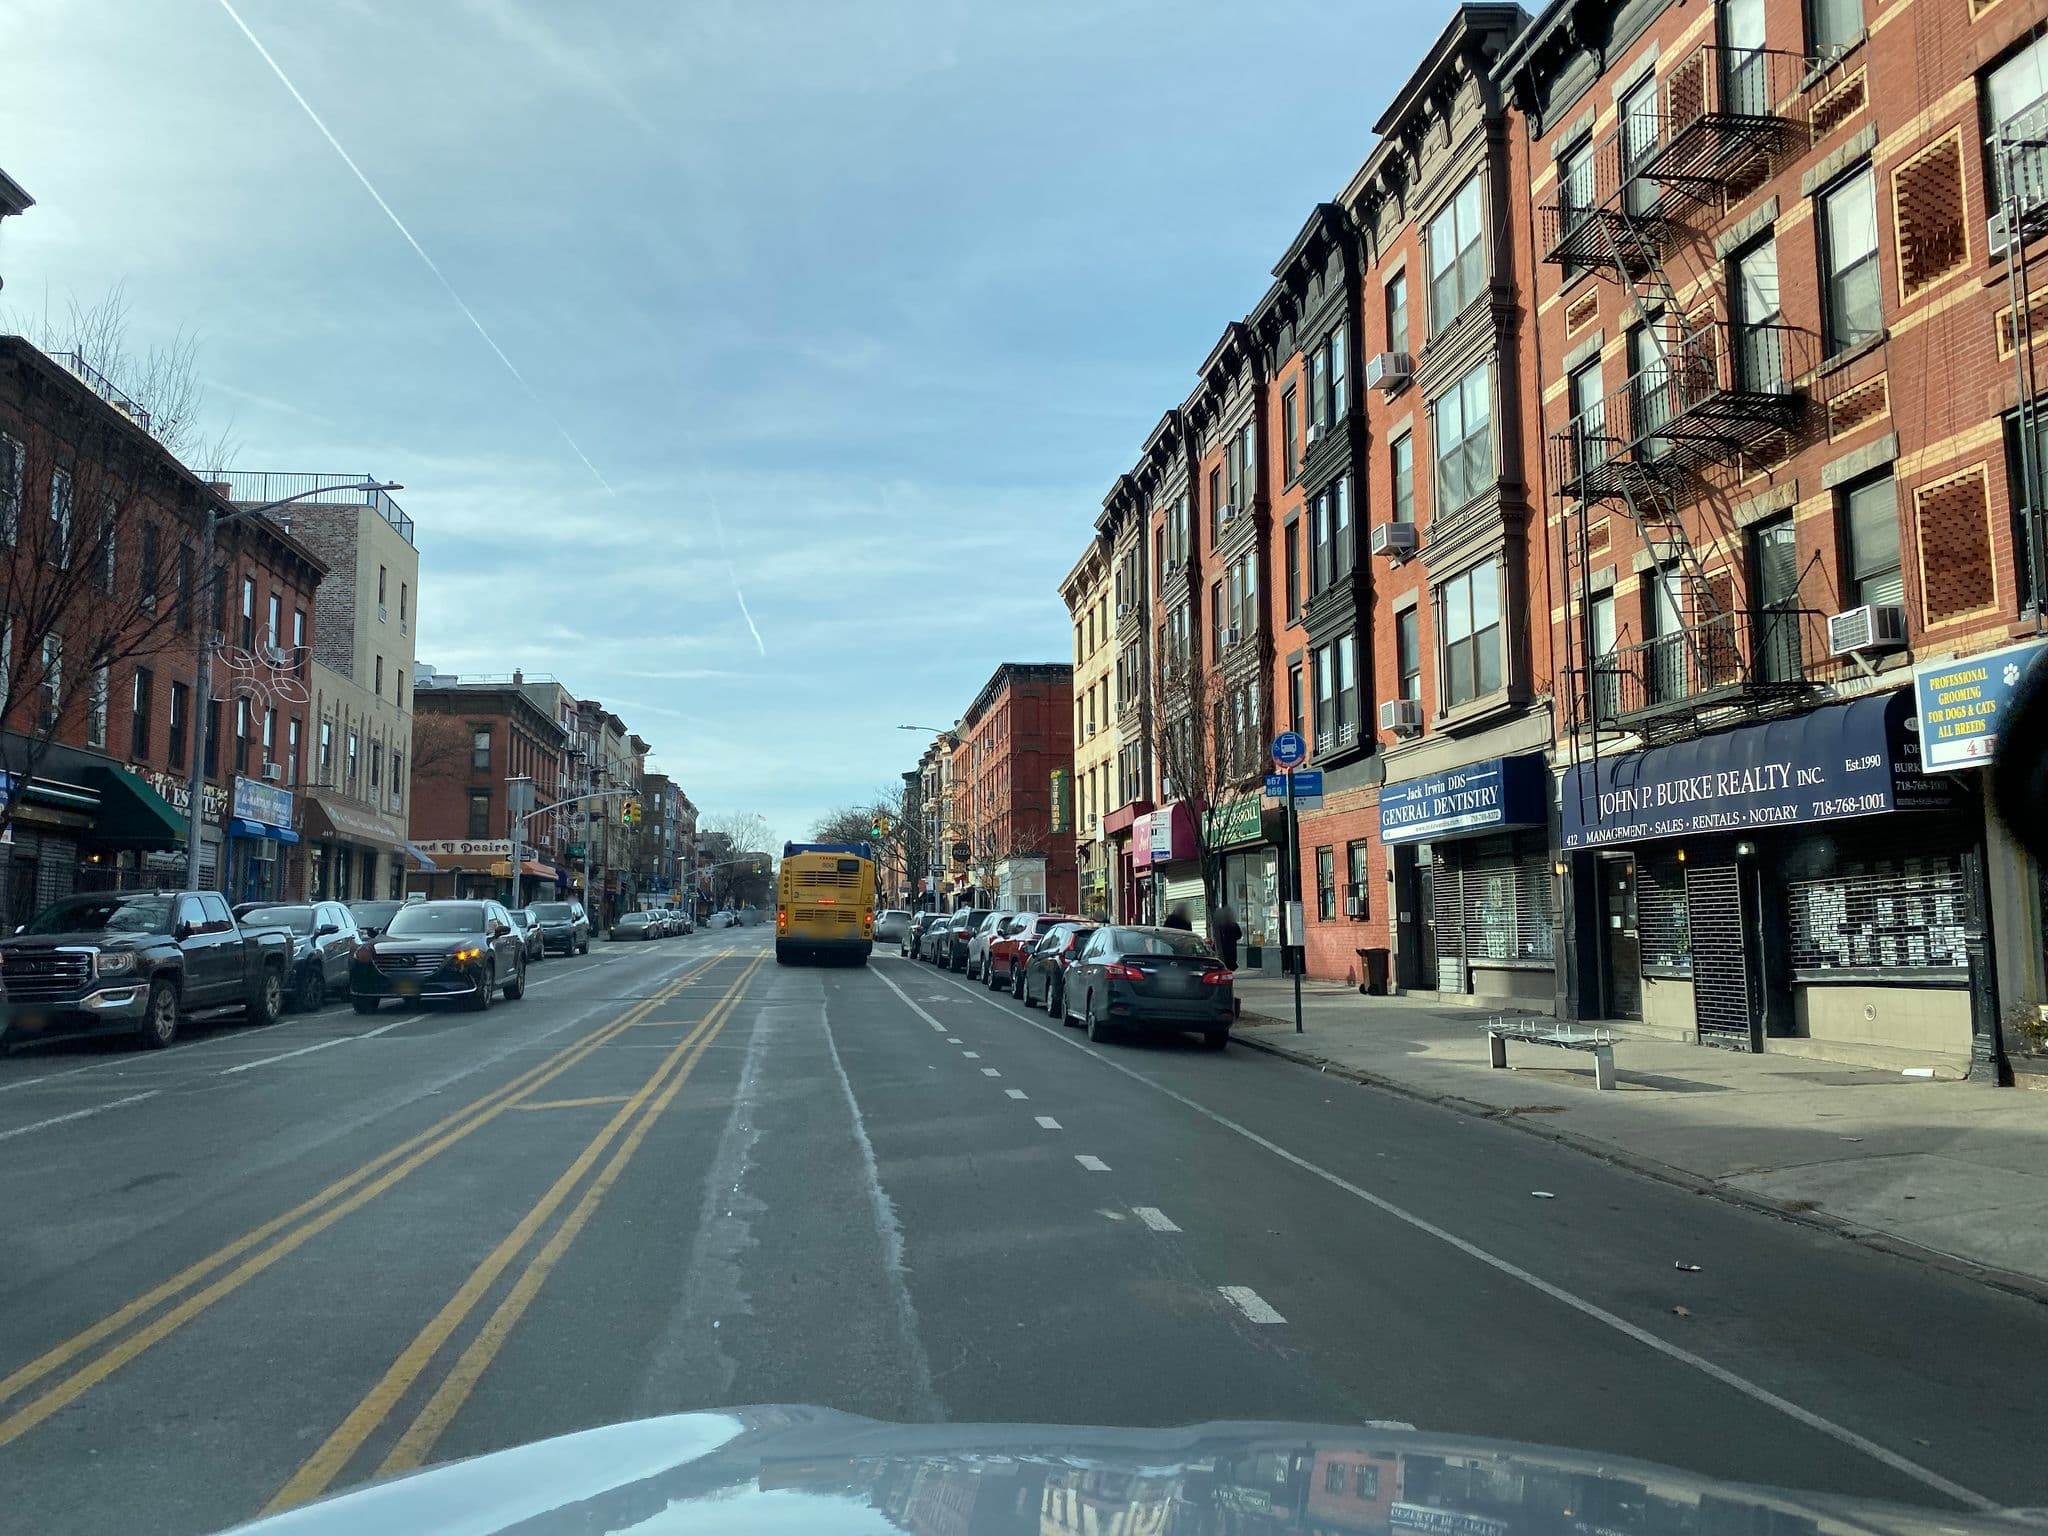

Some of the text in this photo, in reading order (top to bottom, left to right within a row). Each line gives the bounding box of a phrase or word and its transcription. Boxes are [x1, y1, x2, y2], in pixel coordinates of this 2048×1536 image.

[1929, 667, 1988, 691] PROFESSIONAL
[1938, 686, 1982, 705] GROOMING
[1928, 700, 1997, 723] FOR DOGS & CATS
[1938, 719, 1986, 738] ALL BREEDS
[1904, 744, 1921, 756] JOH
[1845, 754, 1881, 772] Est.1990
[1894, 762, 1921, 773] BURK
[1406, 774, 1466, 801] Jack Irwin DDS
[1600, 762, 1825, 820] JOHN P. BURKE REALTY INC.
[1382, 801, 1430, 826] GENERAL
[1434, 785, 1499, 816] DENTISTRY
[1566, 834, 1578, 847] 412
[1586, 823, 1648, 844] MANAGEMENT
[1655, 818, 1684, 834] SALES
[1692, 811, 1740, 828] RENTALS
[1749, 805, 1798, 823] NOTARY
[1812, 792, 1886, 817] 718-768-1001
[441, 842, 455, 854] U
[460, 842, 509, 854] Desire
